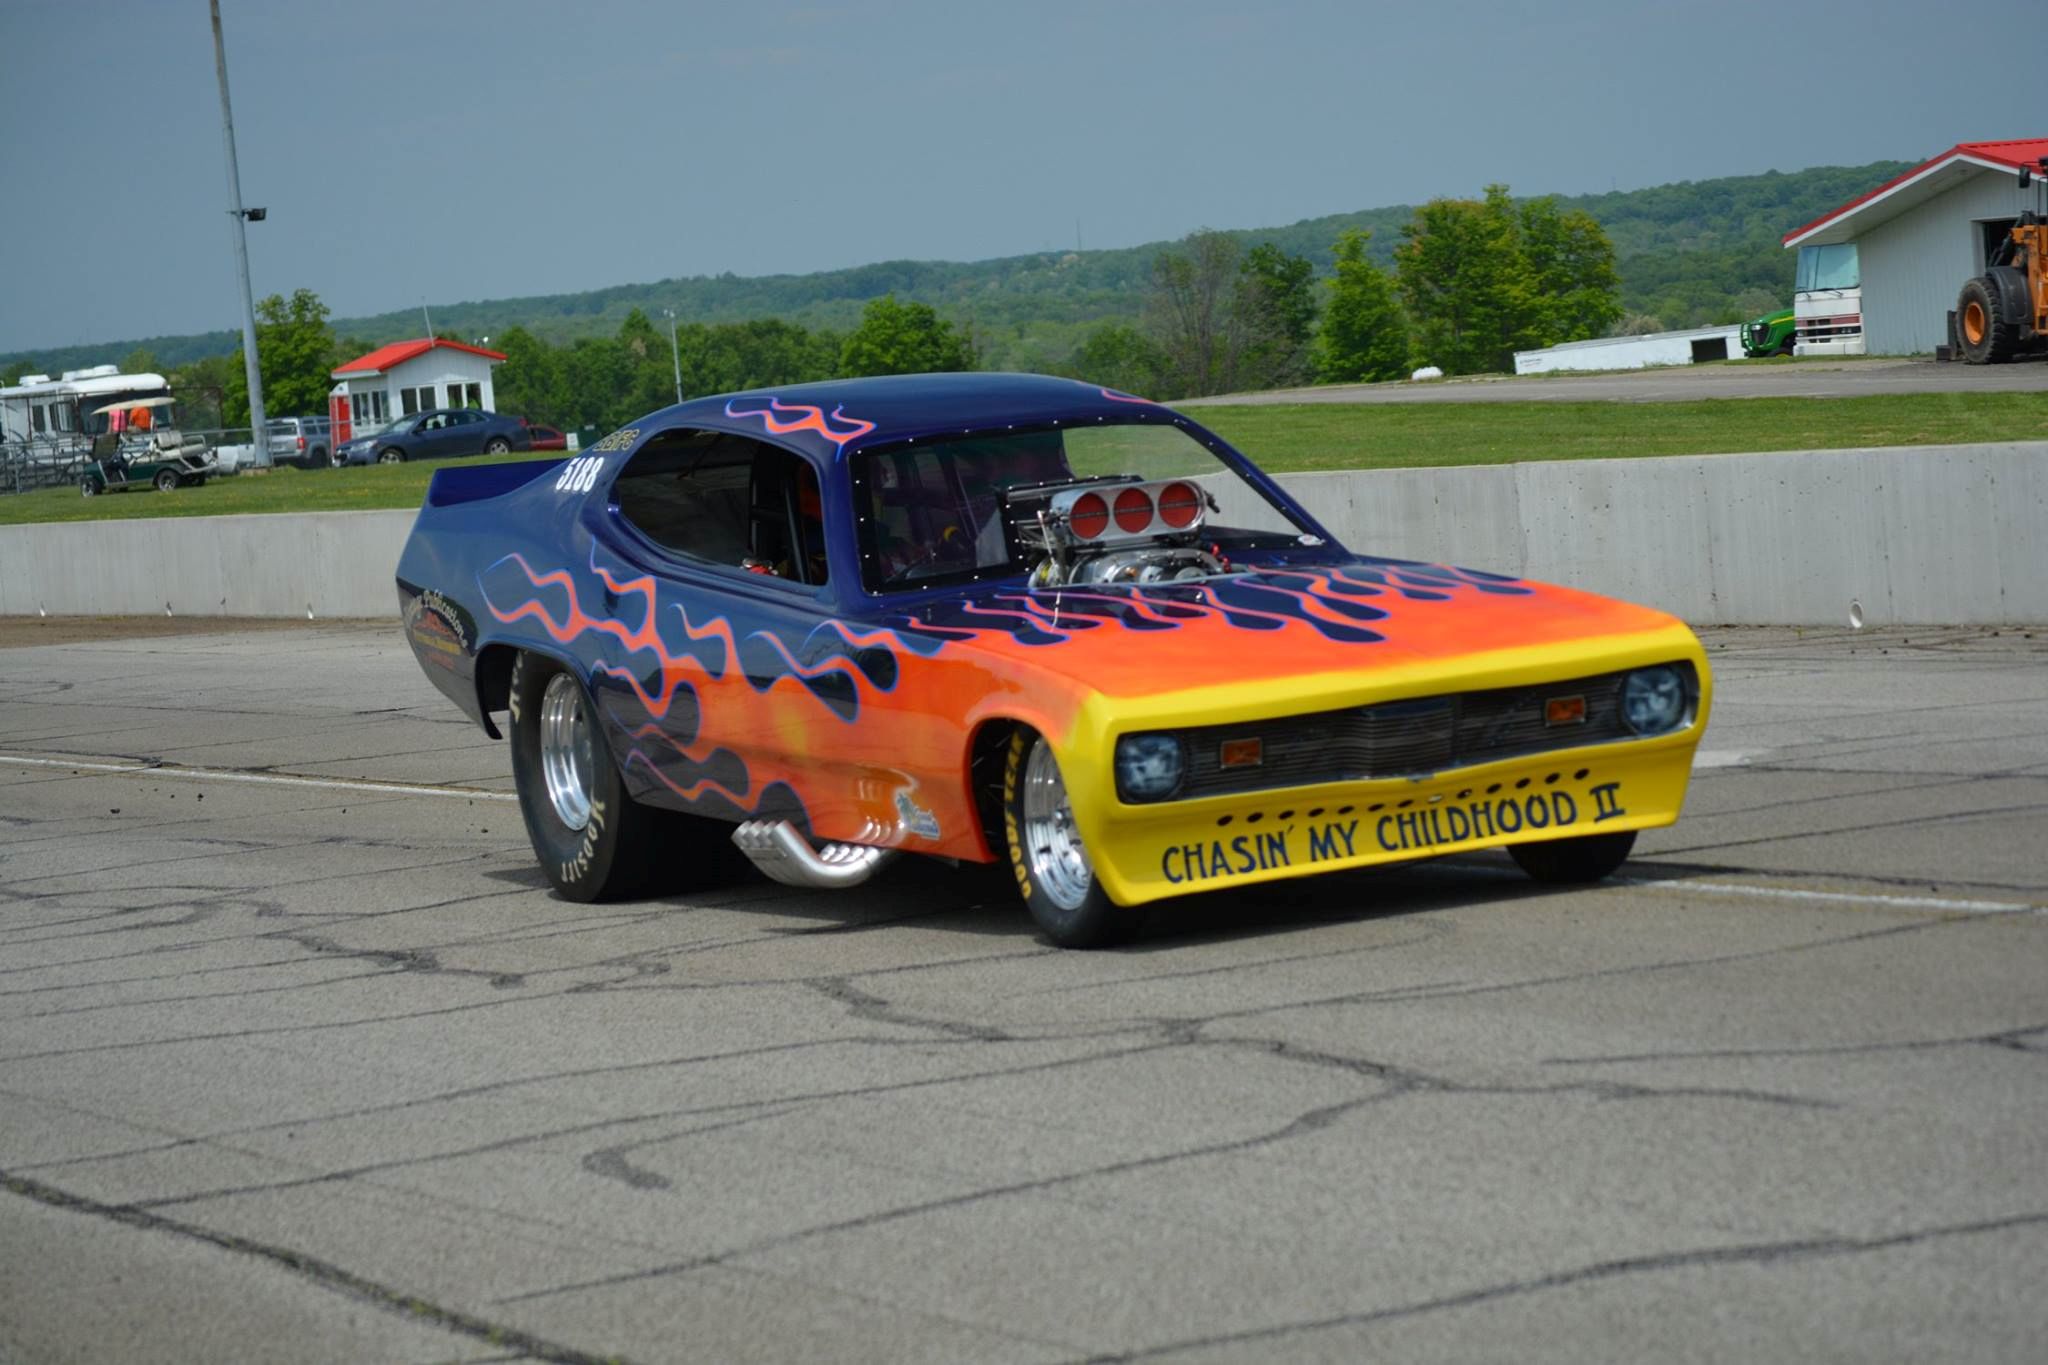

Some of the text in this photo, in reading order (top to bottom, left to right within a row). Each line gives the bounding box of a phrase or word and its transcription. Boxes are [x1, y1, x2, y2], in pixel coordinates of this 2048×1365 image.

[555, 456, 605, 494] 5188
[1162, 782, 1626, 885] CHASIN' MY CHILDHOOD II
